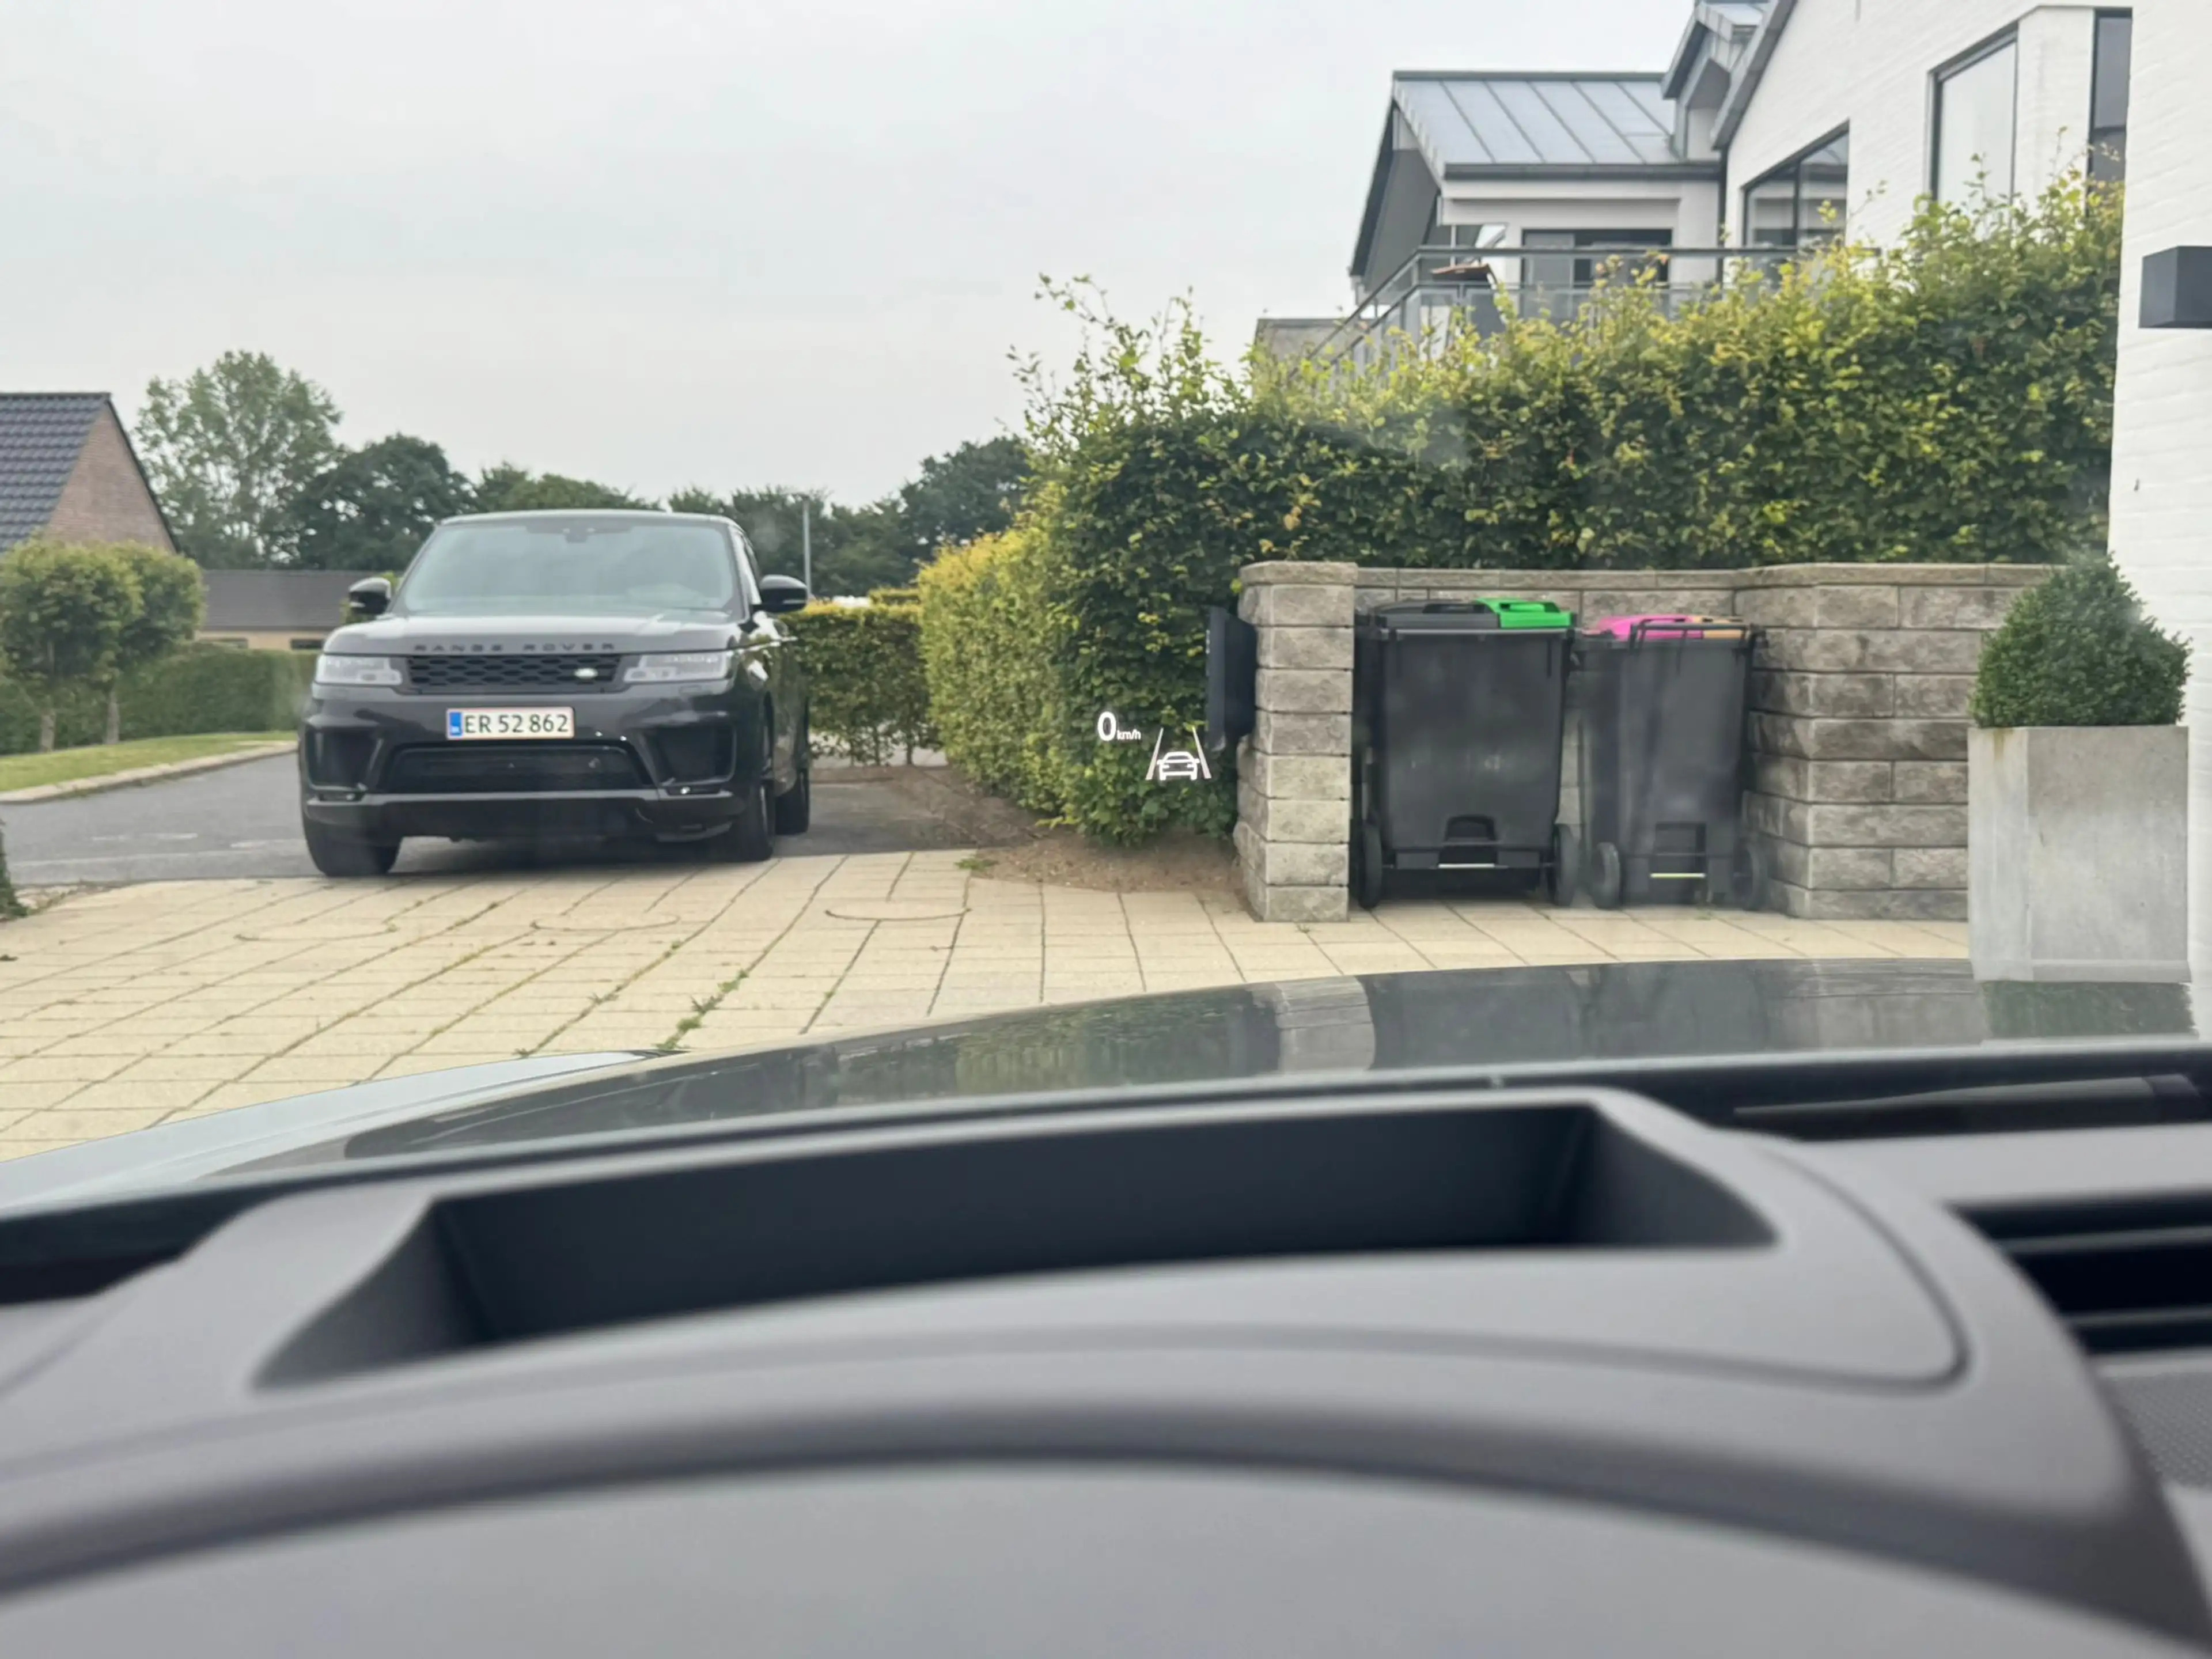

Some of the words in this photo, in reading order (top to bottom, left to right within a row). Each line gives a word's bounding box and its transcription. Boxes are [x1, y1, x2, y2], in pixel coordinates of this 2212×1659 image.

[414, 643, 503, 652] RANGE
[522, 642, 614, 652] ROVER
[465, 715, 491, 733] ER
[498, 715, 524, 733] 52
[529, 714, 569, 732] 862
[1097, 711, 1116, 741] 0
[1116, 729, 1141, 740] km/h
